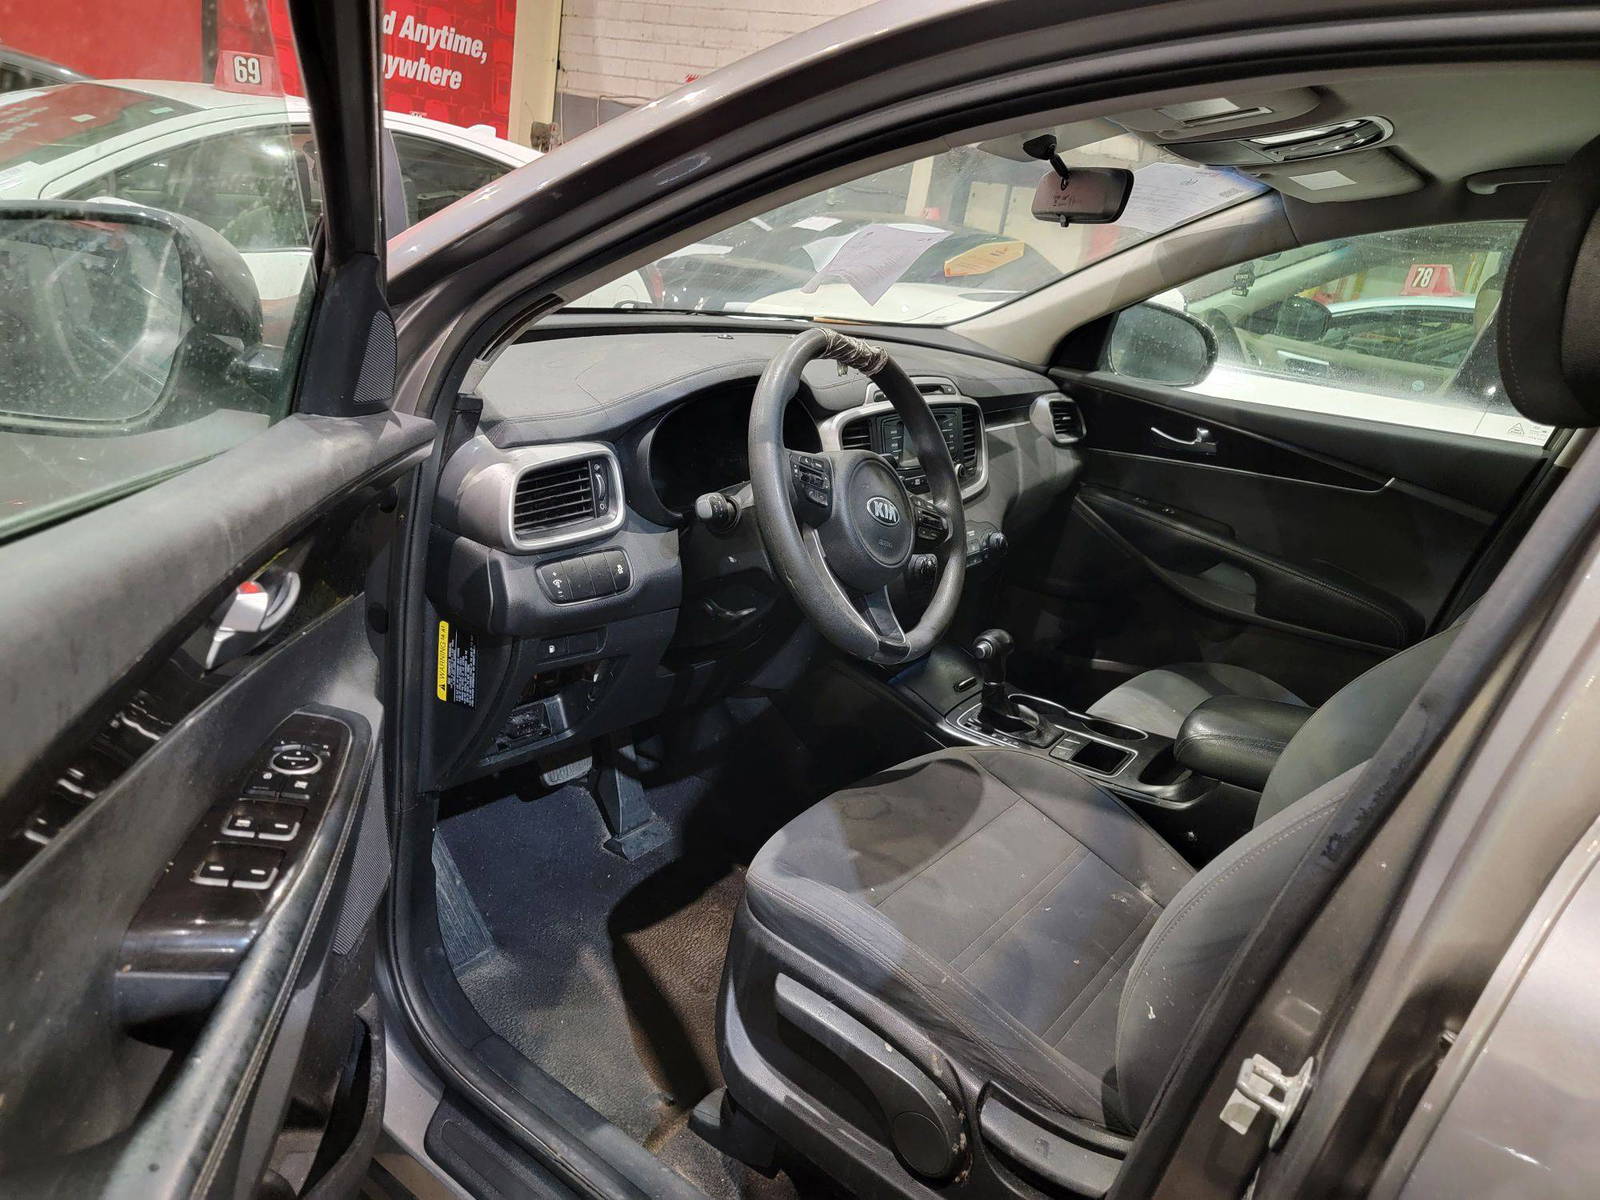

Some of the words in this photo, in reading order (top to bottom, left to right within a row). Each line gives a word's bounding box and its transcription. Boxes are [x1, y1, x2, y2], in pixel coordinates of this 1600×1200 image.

[399, 15, 488, 64] Anytime,
[233, 55, 262, 84] 69
[383, 53, 463, 90] ywhere
[1411, 267, 1434, 288] 78
[873, 500, 897, 522] KIA
[439, 641, 447, 680] WARNING
